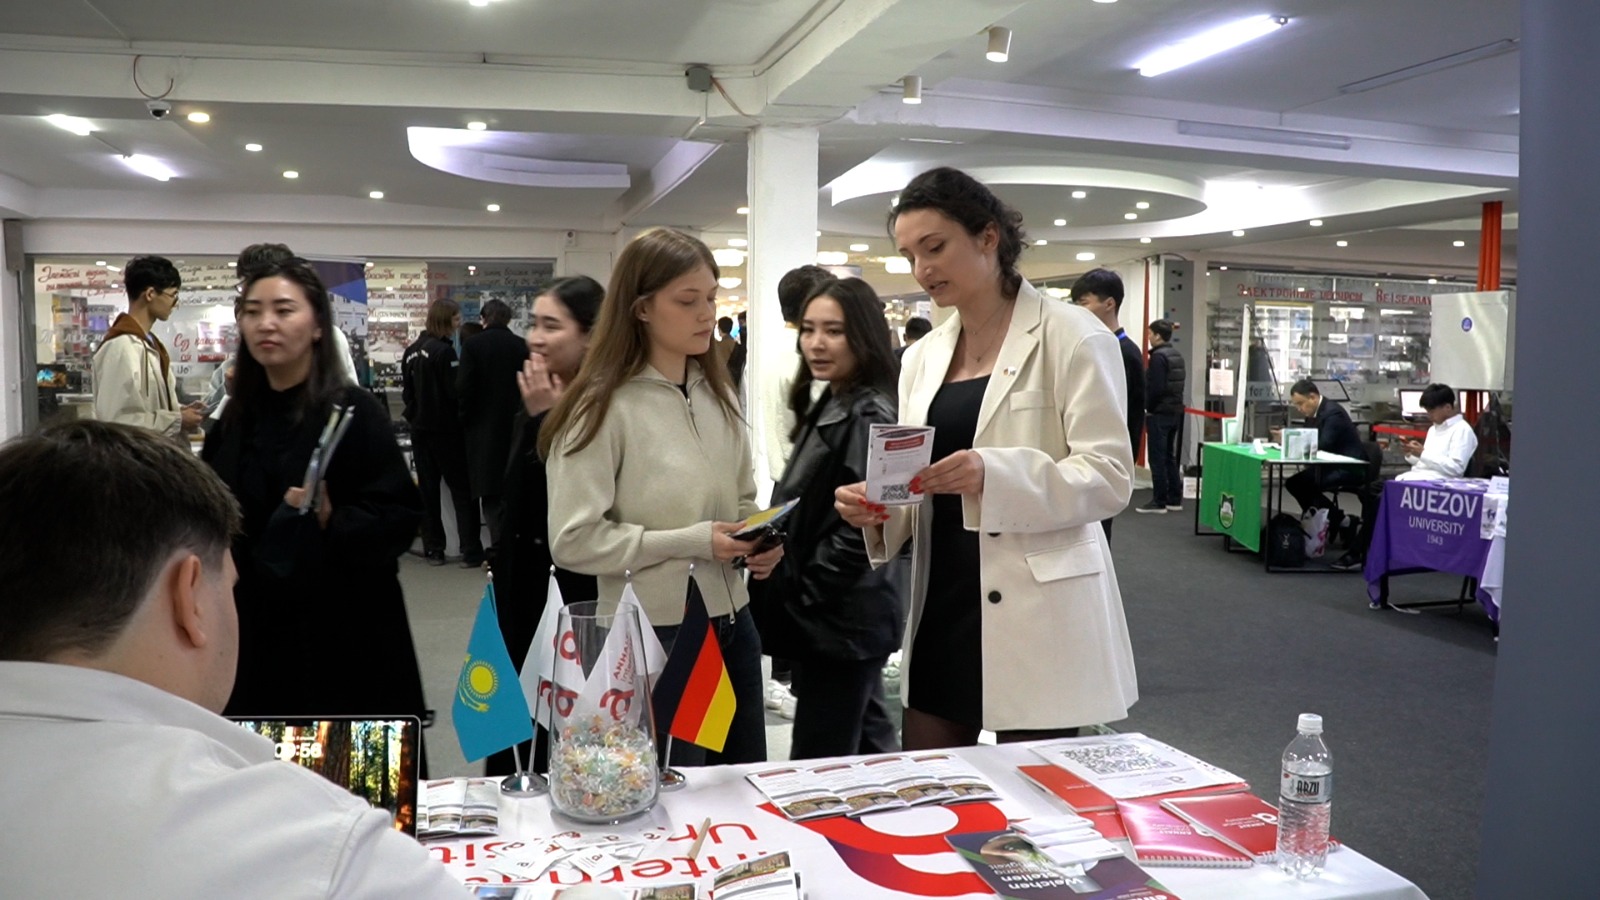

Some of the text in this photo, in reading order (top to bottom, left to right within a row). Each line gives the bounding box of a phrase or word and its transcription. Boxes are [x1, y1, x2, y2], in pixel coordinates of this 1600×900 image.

[1400, 486, 1478, 519] AUEZOV
[1408, 516, 1465, 536] UNIVERSITY
[1427, 534, 1444, 546] 1943
[1296, 780, 1320, 795] ARZU
